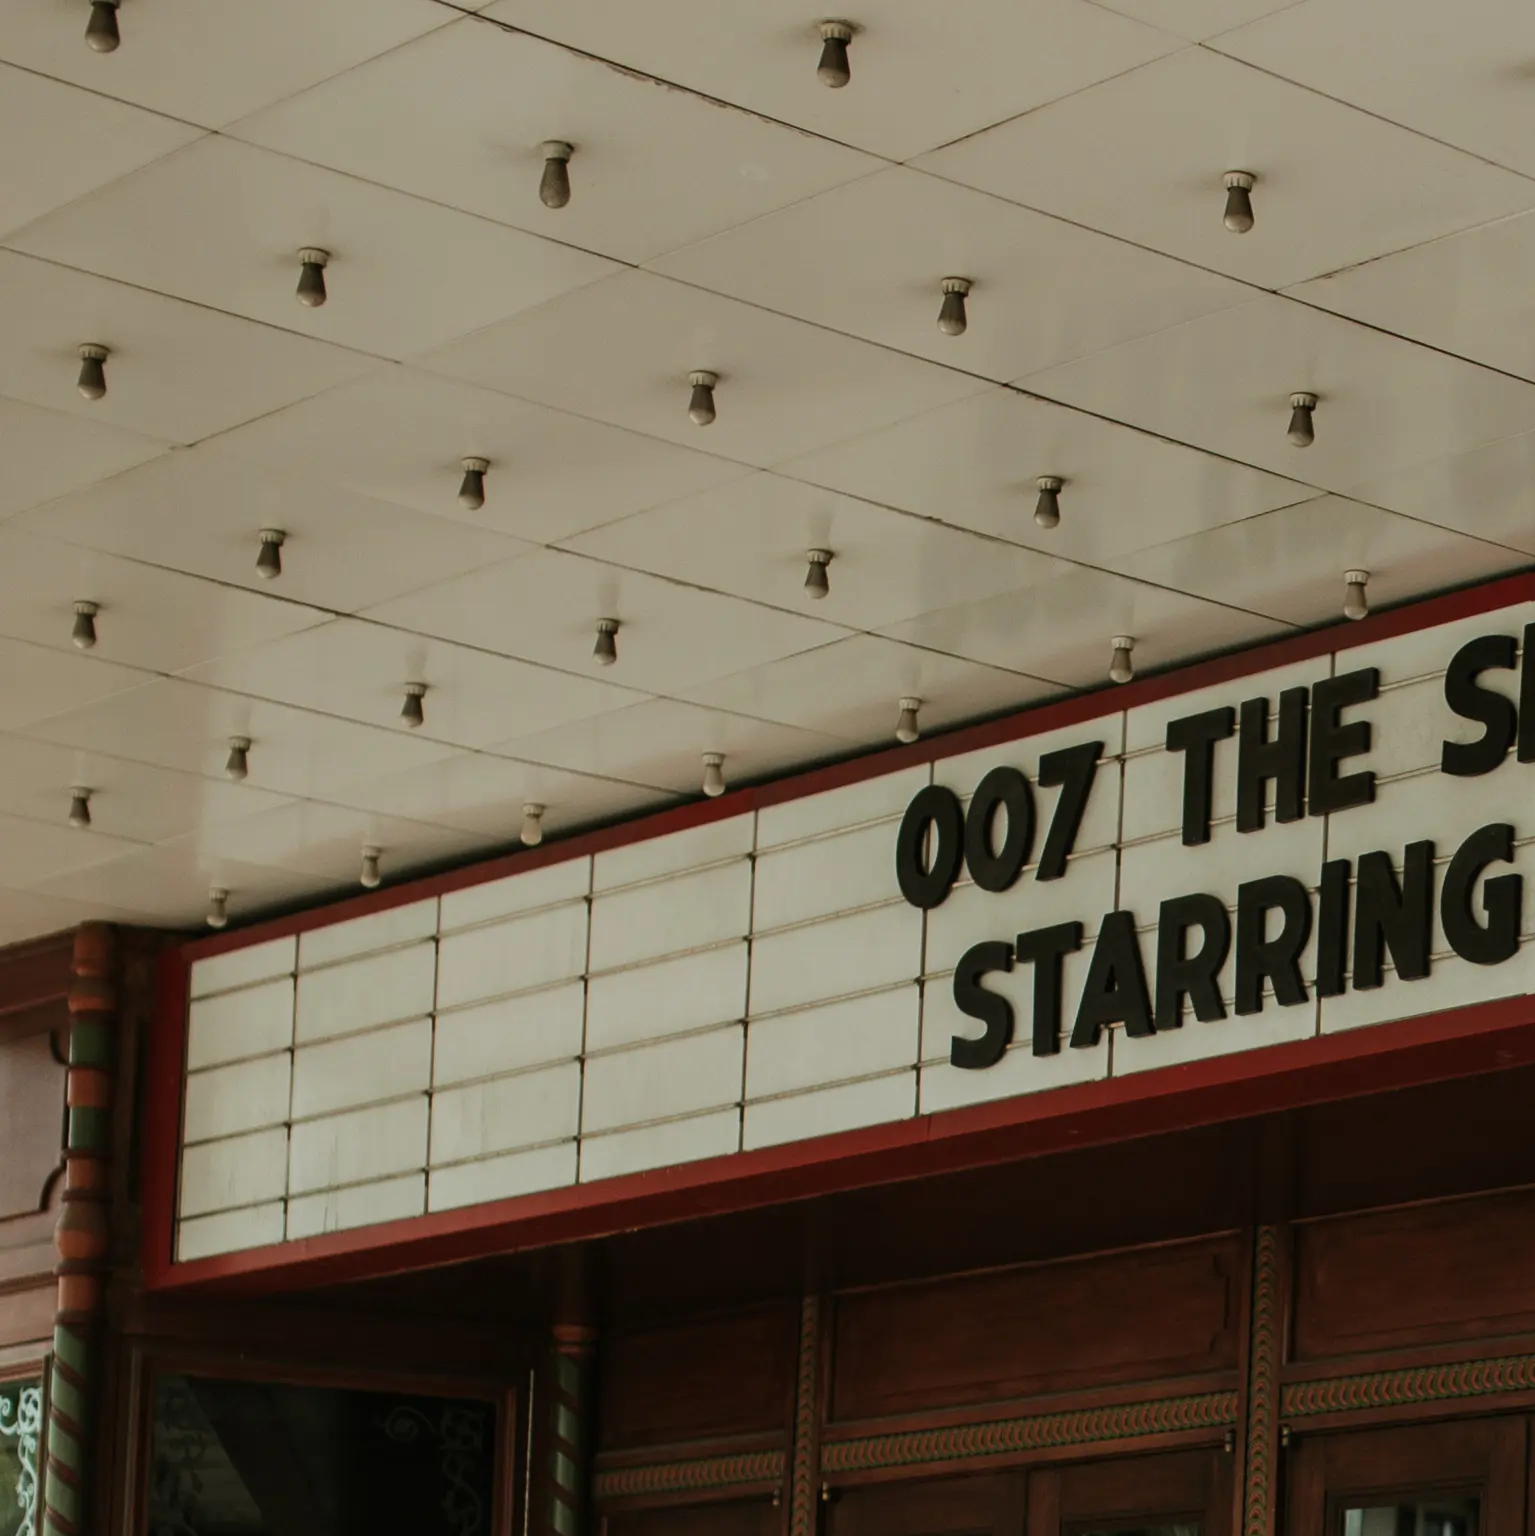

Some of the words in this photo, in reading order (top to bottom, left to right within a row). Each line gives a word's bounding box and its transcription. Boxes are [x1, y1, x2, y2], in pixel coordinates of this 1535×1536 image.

[895, 740, 1105, 909] 007
[1166, 666, 1381, 847] THE
[950, 822, 1524, 1069] STARRING
